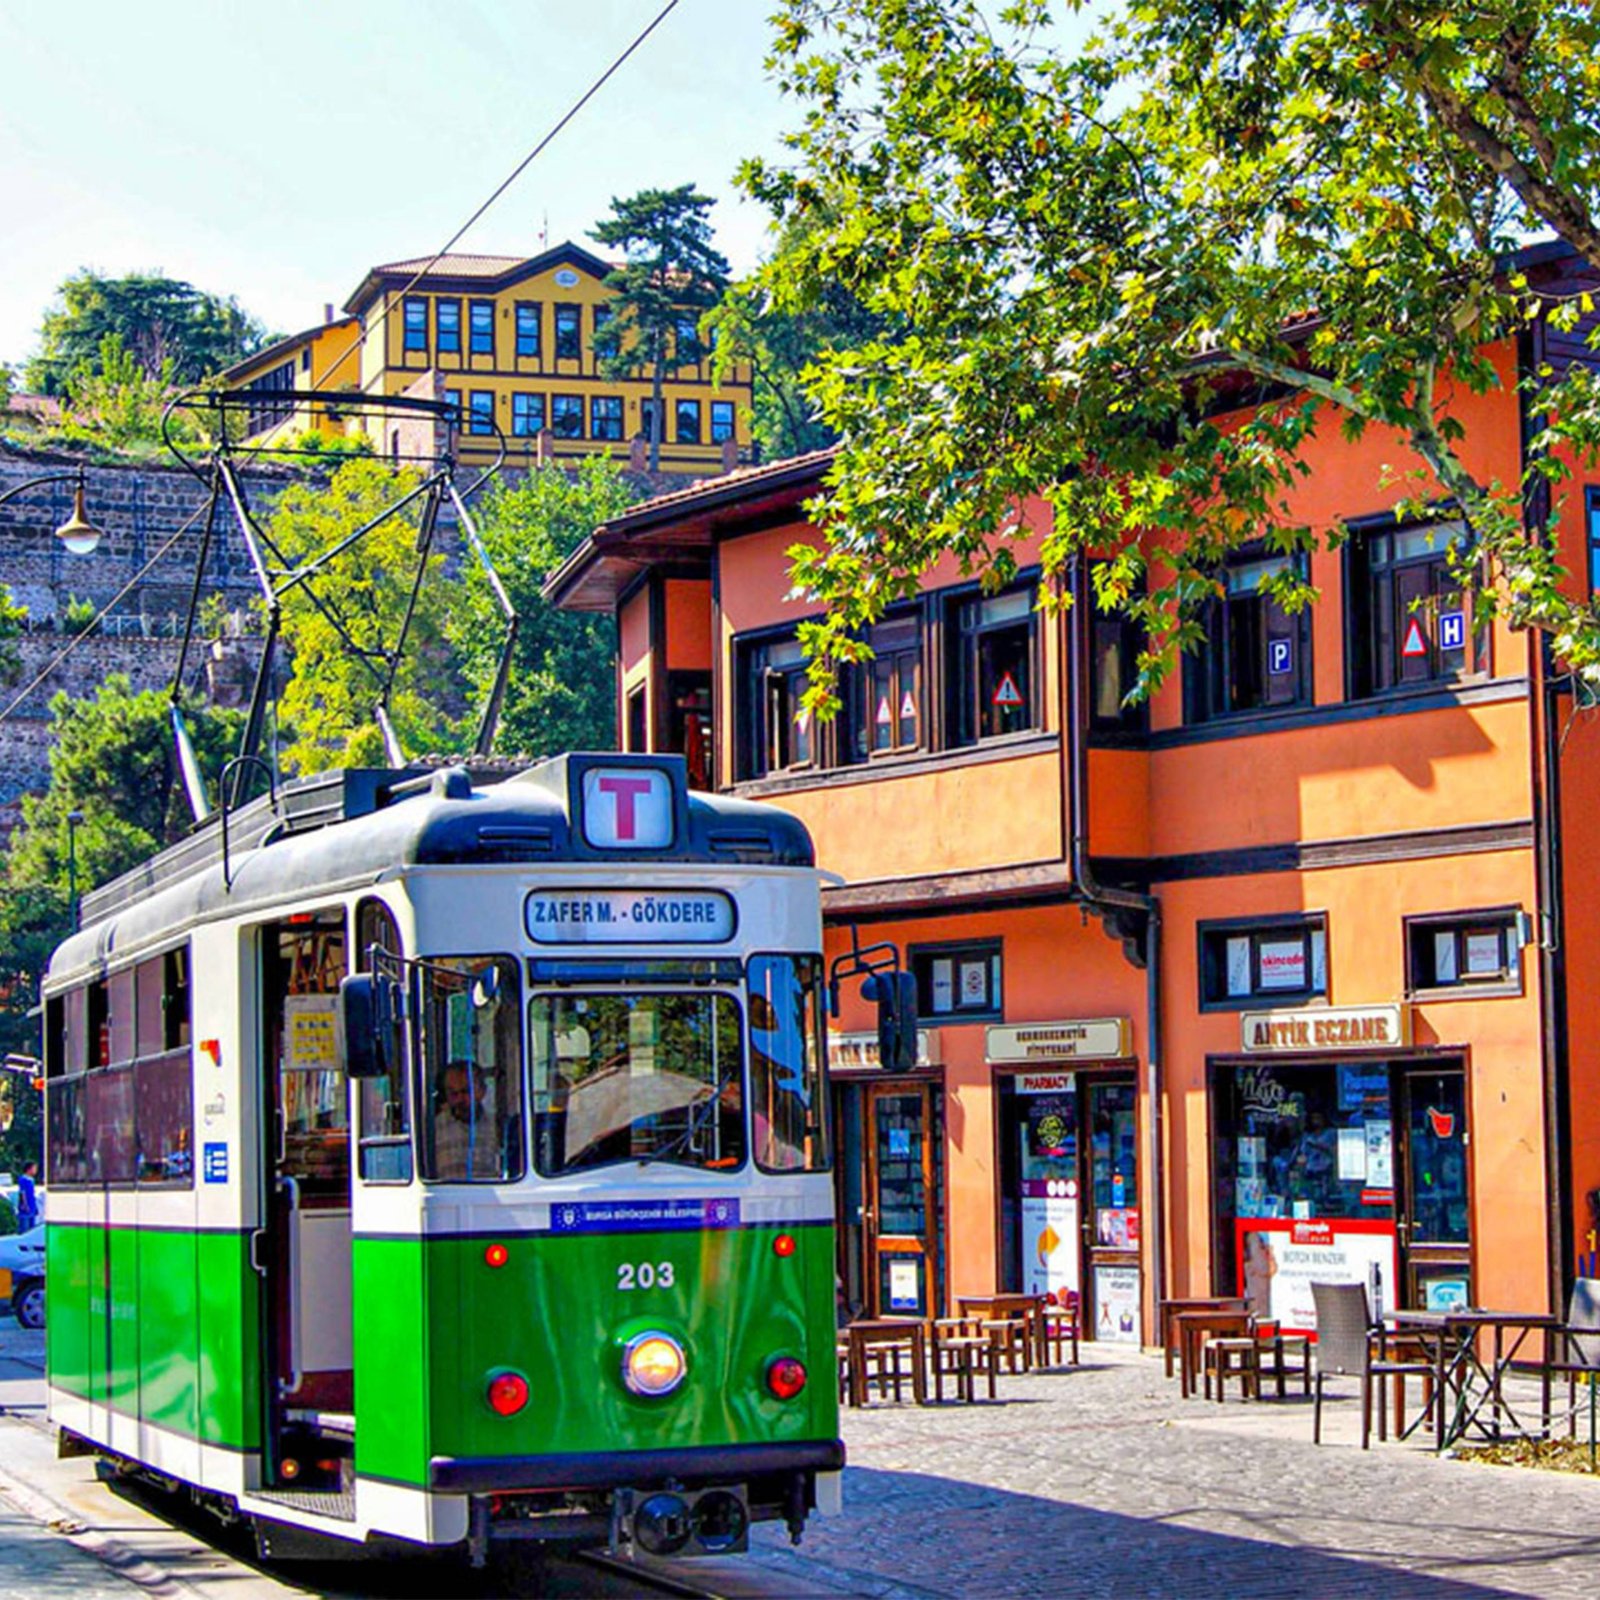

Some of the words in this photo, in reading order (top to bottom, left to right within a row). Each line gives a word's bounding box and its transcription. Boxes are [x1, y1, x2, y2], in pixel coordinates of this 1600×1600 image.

[1444, 618, 1459, 645] H
[1274, 644, 1287, 670] P
[600, 778, 650, 840] T
[534, 902, 593, 923] ZAFER
[597, 902, 617, 923] M.
[631, 897, 716, 923] GÖKDERE
[1254, 1016, 1309, 1045] ANTİK
[1314, 1017, 1388, 1043] ECZANE
[1024, 1075, 1069, 1090] PHARMACY
[617, 1262, 675, 1289] 203
